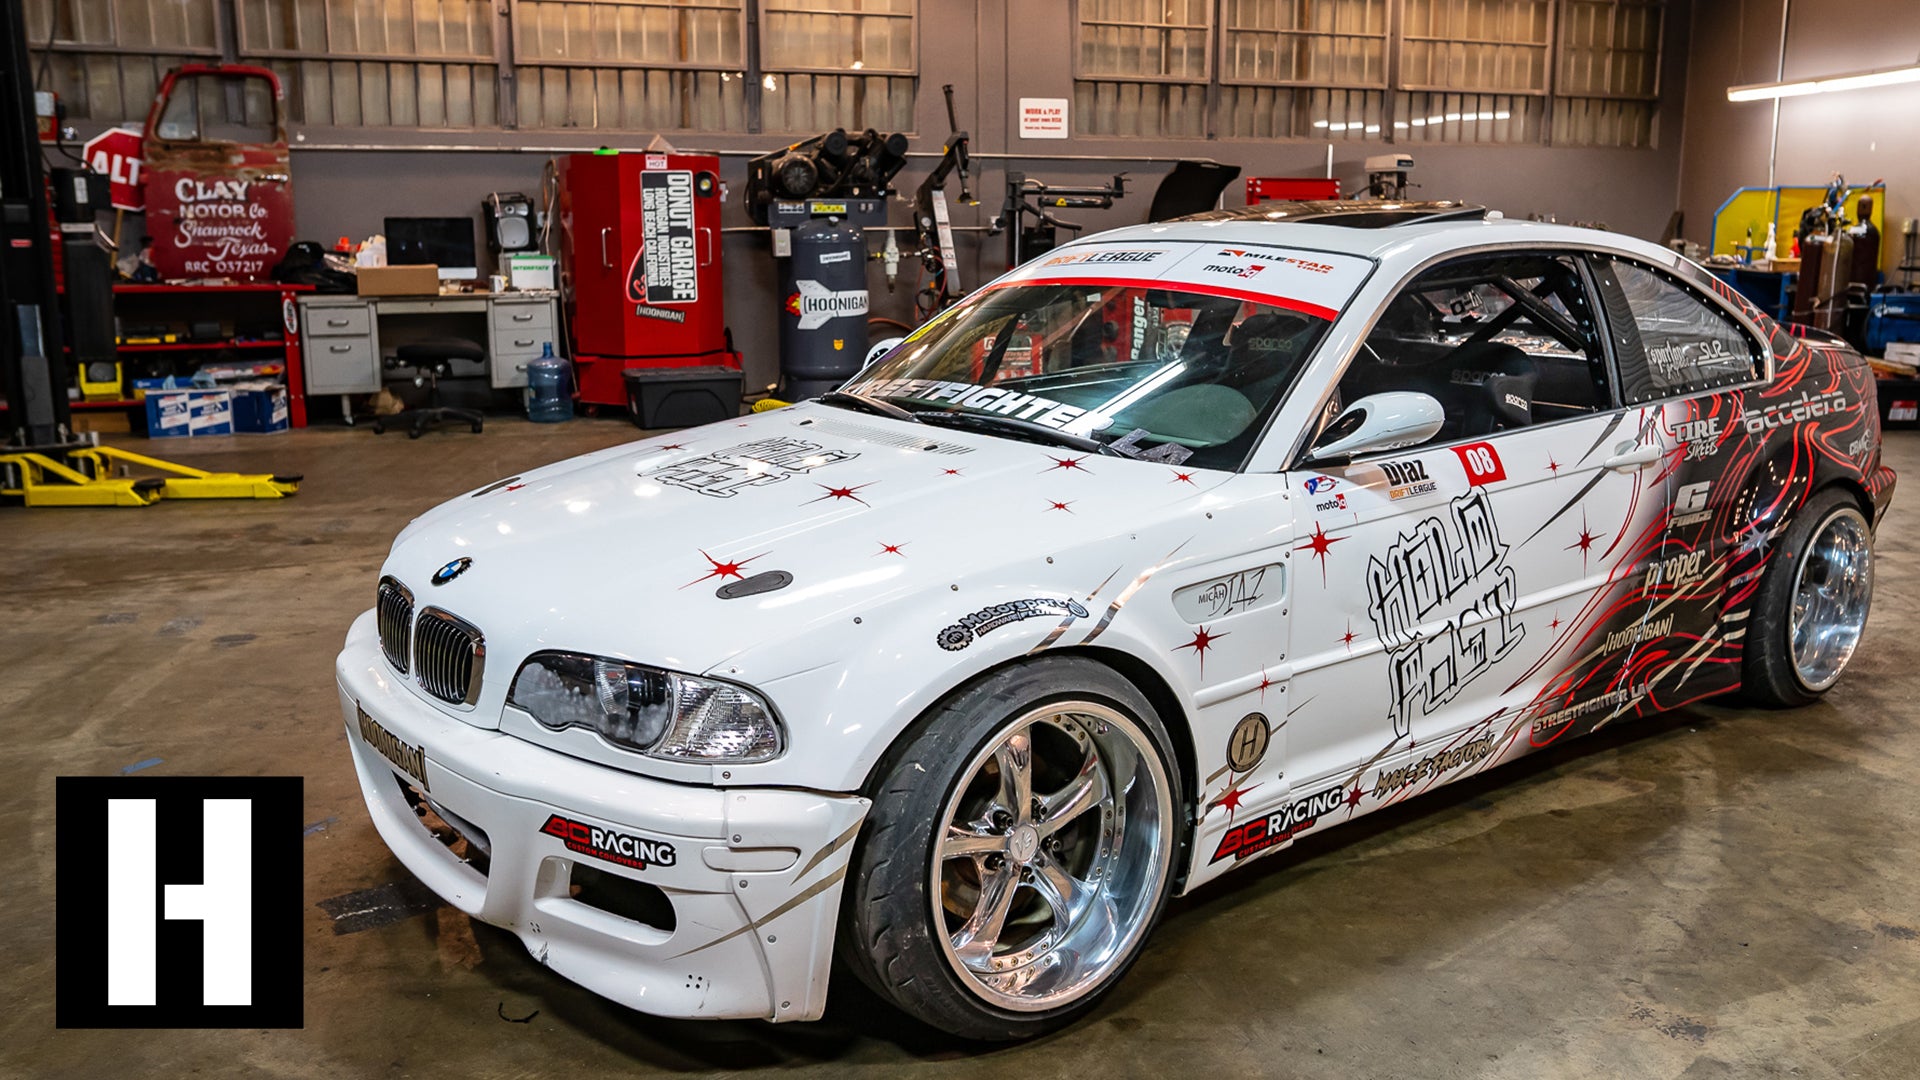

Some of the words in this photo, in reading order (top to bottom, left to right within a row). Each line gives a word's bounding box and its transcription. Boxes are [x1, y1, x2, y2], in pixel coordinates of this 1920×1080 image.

[91, 150, 144, 186] ALT
[175, 178, 249, 203] CLAY
[643, 188, 655, 210] LONG
[667, 174, 692, 229] DONUT
[179, 204, 246, 219] MOTOR
[644, 211, 657, 239] BEACH
[655, 187, 670, 233] HOONIGAN
[174, 221, 267, 248] Shamrock
[206, 236, 277, 261] Texas
[216, 261, 264, 273] 037217
[646, 240, 659, 287] CALIFORNIA
[657, 235, 672, 287] INDUSTRIES
[671, 236, 695, 300] GARAGE
[1244, 252, 1334, 271] MILESTAR
[1670, 416, 1723, 444] TIRE
[1746, 391, 1847, 434] accelera
[1465, 446, 1497, 477] 08
[1673, 480, 1712, 517] G
[1205, 567, 1266, 617] DIAZ
[1641, 549, 1706, 599] proper
[1198, 588, 1225, 605] MICAH
[1532, 688, 1628, 733] STREETFIGHTER
[1267, 788, 1342, 836] RACING
[566, 841, 599, 857] CUSTOM
[591, 828, 674, 866] RACING
